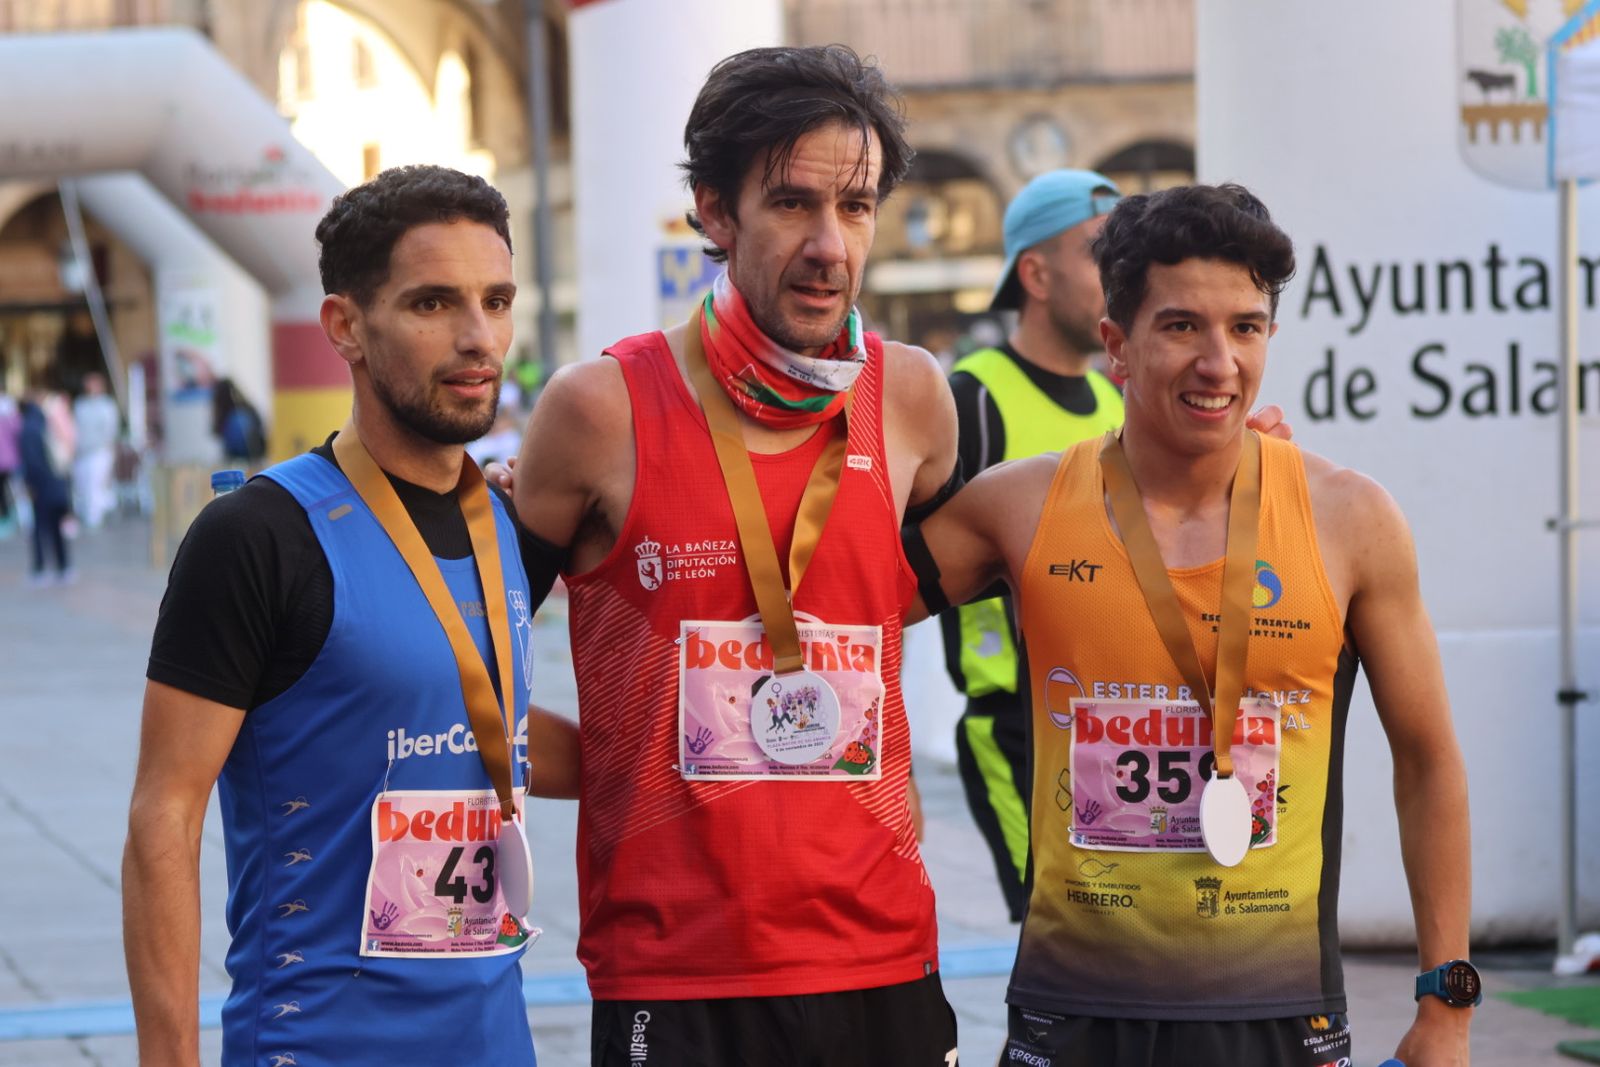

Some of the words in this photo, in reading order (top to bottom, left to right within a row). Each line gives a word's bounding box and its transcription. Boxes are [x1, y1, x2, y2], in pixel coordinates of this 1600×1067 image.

[1304, 347, 1379, 423] de
[666, 544, 681, 555] LA
[685, 539, 736, 553] BAÑEZA
[666, 554, 737, 570] DIPUTACIÓN
[1048, 559, 1103, 583] EKT
[666, 571, 681, 581] DE
[685, 567, 716, 579] LEÓN
[1092, 681, 1168, 700] ESTER
[387, 723, 480, 761] iberCa
[434, 845, 495, 905] 43
[1067, 888, 1133, 908] HERRERO
[1223, 888, 1289, 903] Ayuntamiento
[1225, 903, 1236, 915] de
[1239, 902, 1291, 914] Salamanca
[1009, 1048, 1051, 1067] ERRERO
